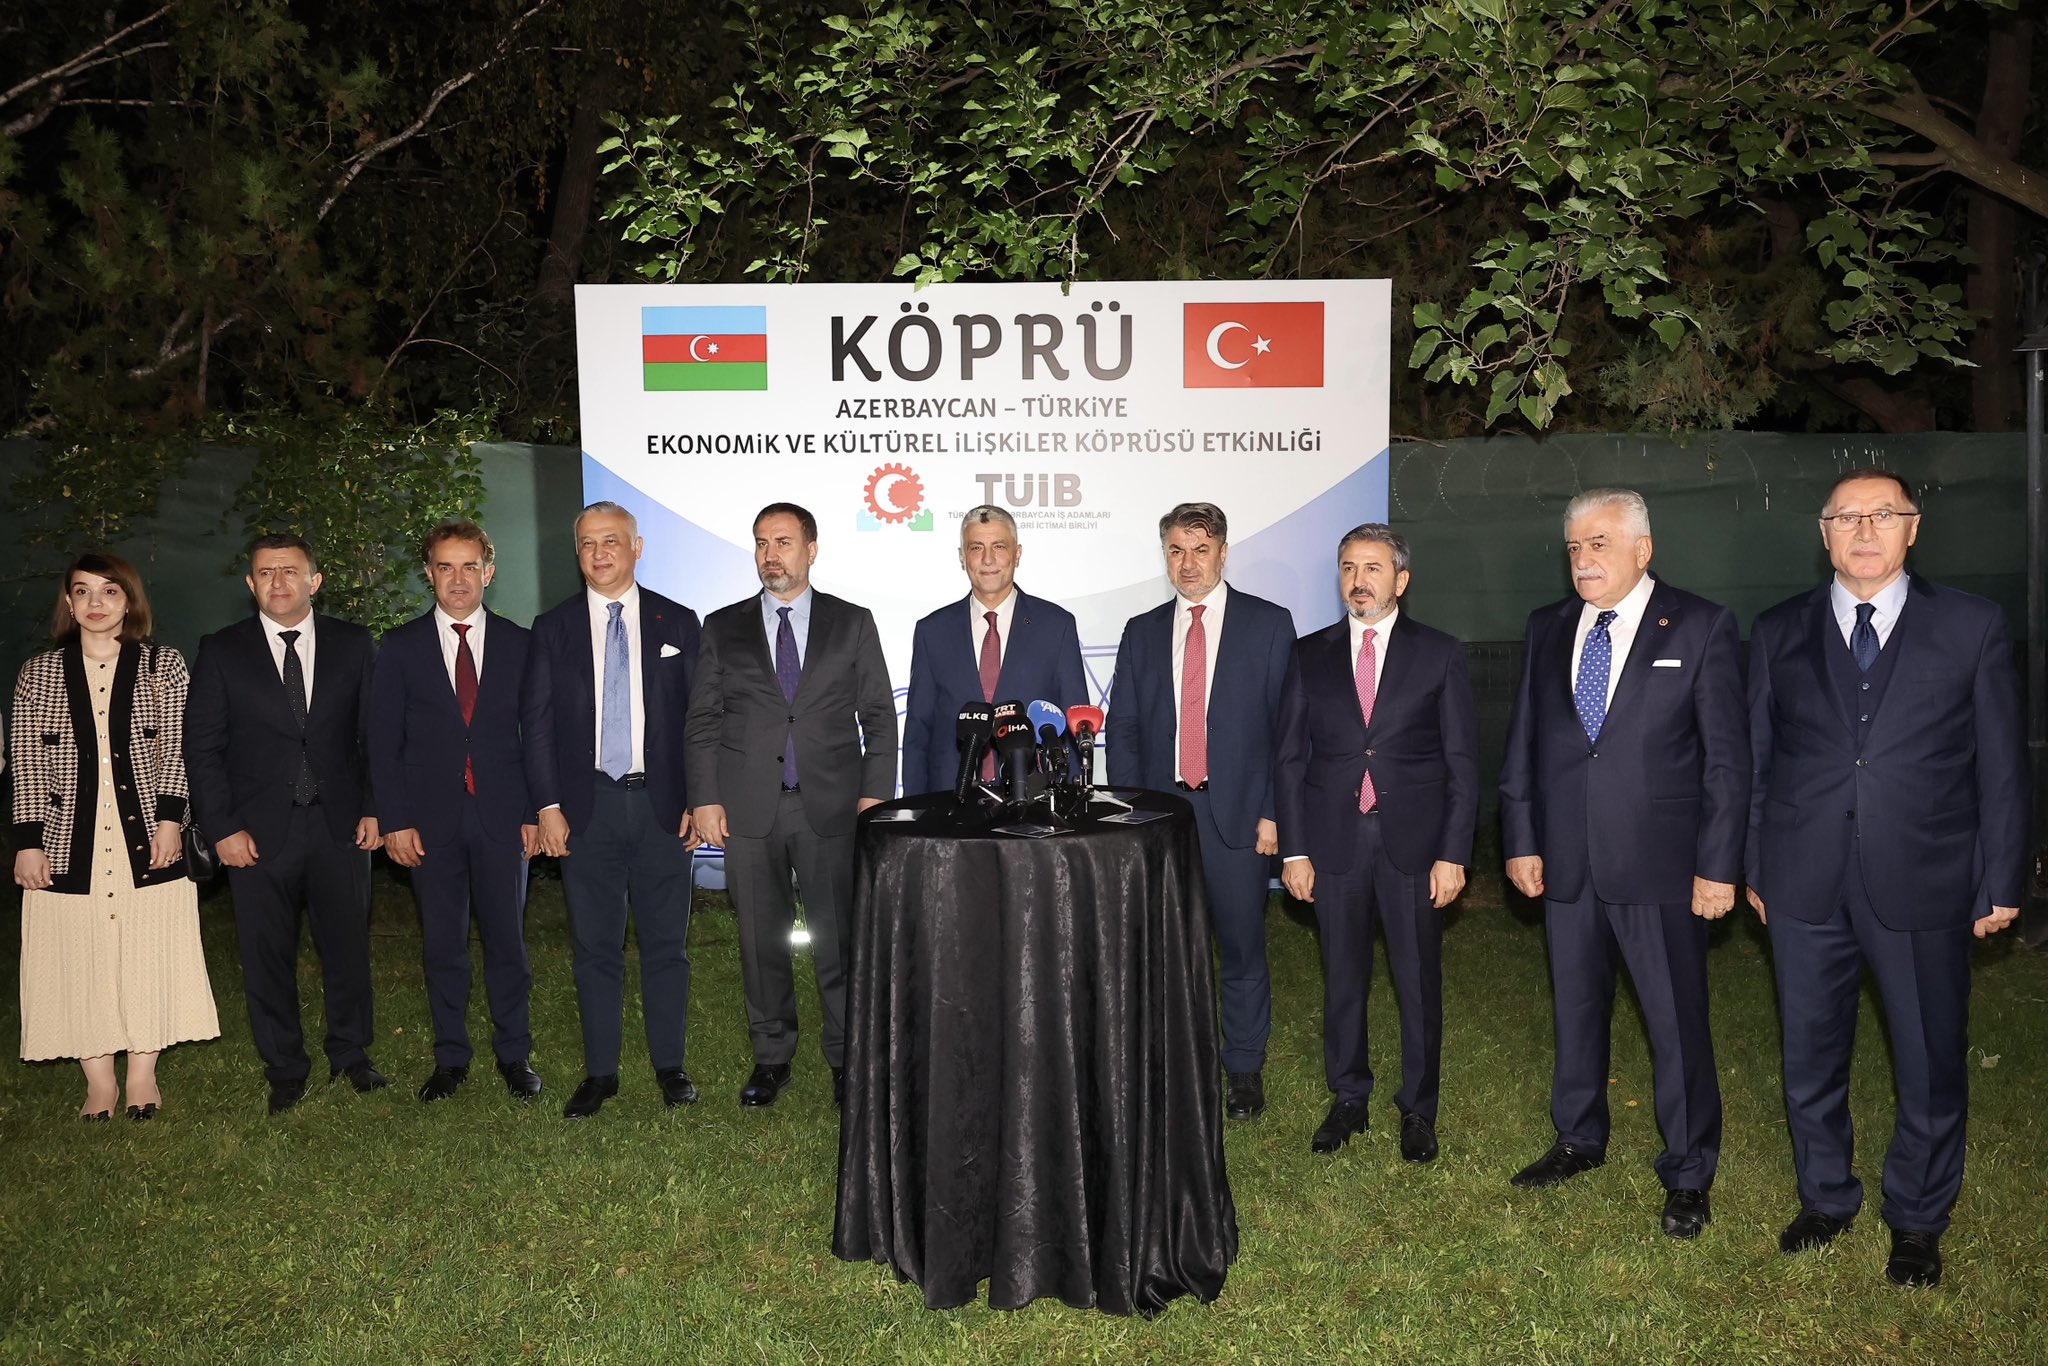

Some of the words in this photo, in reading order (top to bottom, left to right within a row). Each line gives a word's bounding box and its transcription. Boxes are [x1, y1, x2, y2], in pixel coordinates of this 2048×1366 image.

[831, 302, 1133, 382] KÖPRÜ
[835, 398, 996, 420] AZERBAYCAN
[785, 433, 817, 454] VE
[823, 430, 949, 454] KÜLTÜREL
[1075, 429, 1195, 453] KÖPRÜSÜ
[1067, 511, 1111, 519] ADAMLARI
[994, 704, 1016, 714] TRT
